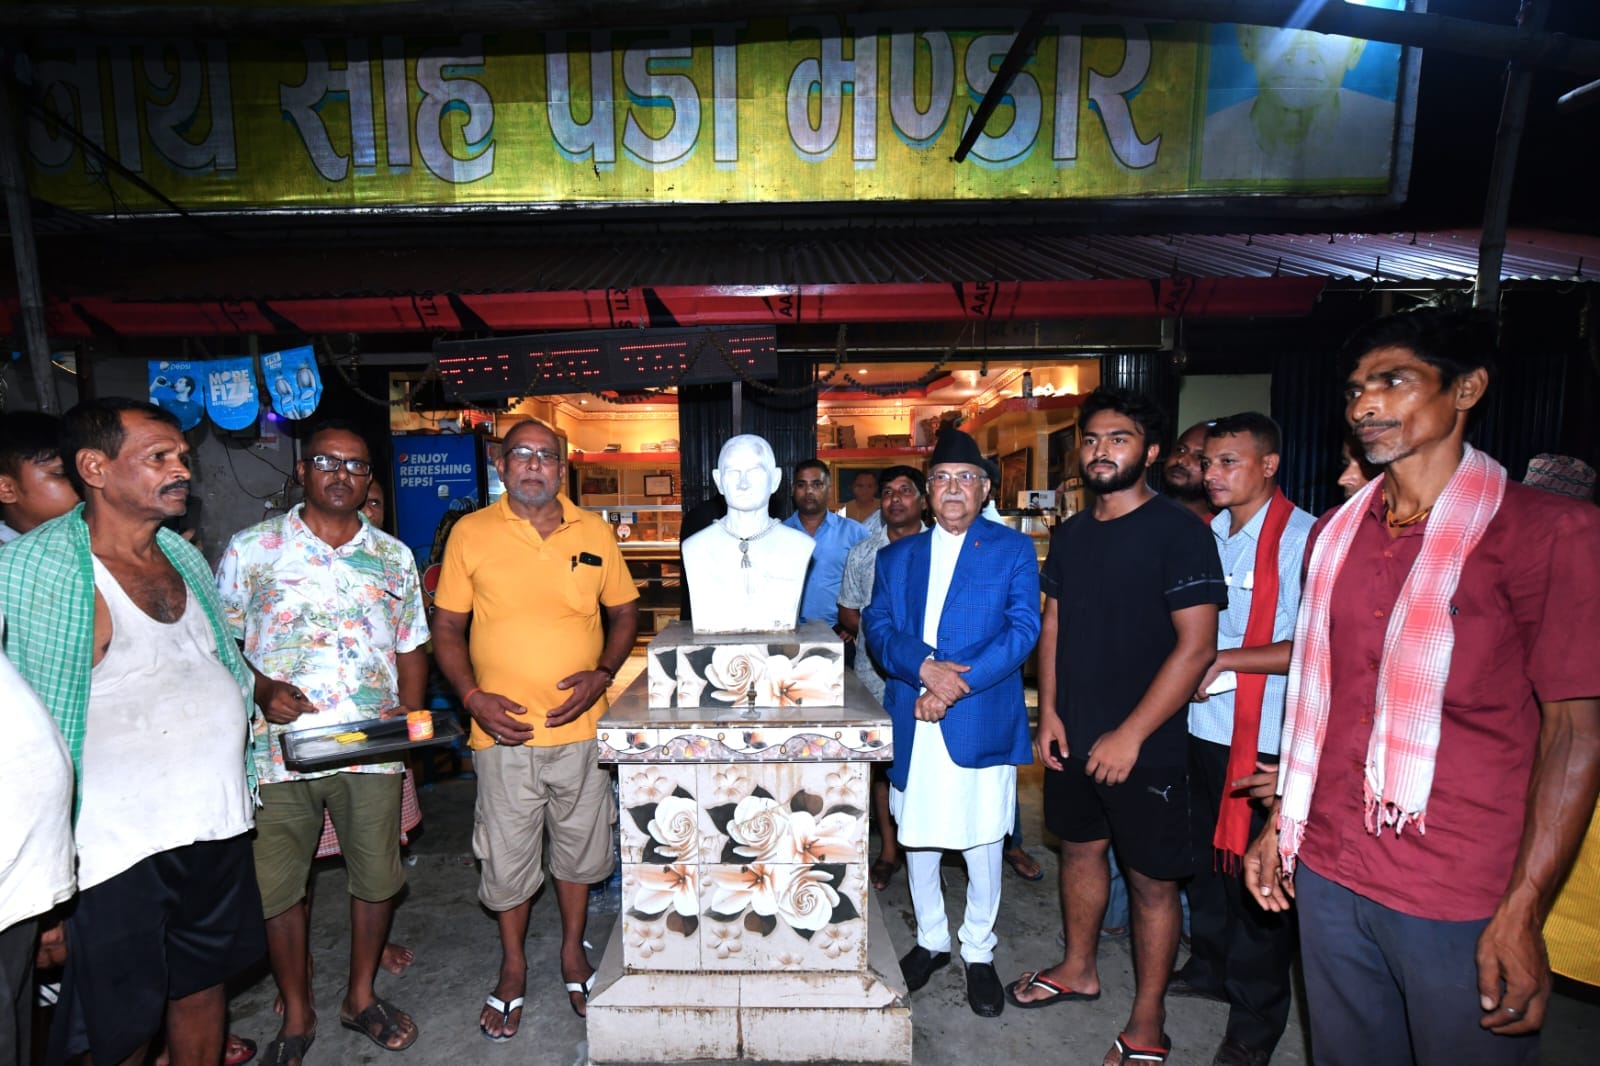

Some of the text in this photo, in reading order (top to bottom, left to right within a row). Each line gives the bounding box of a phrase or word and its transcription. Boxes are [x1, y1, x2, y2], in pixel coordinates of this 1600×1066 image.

[209, 370, 249, 384] MORE
[411, 453, 448, 464] ENJOY
[400, 463, 472, 476] REFRESHING
[400, 476, 433, 488] PEPSI
